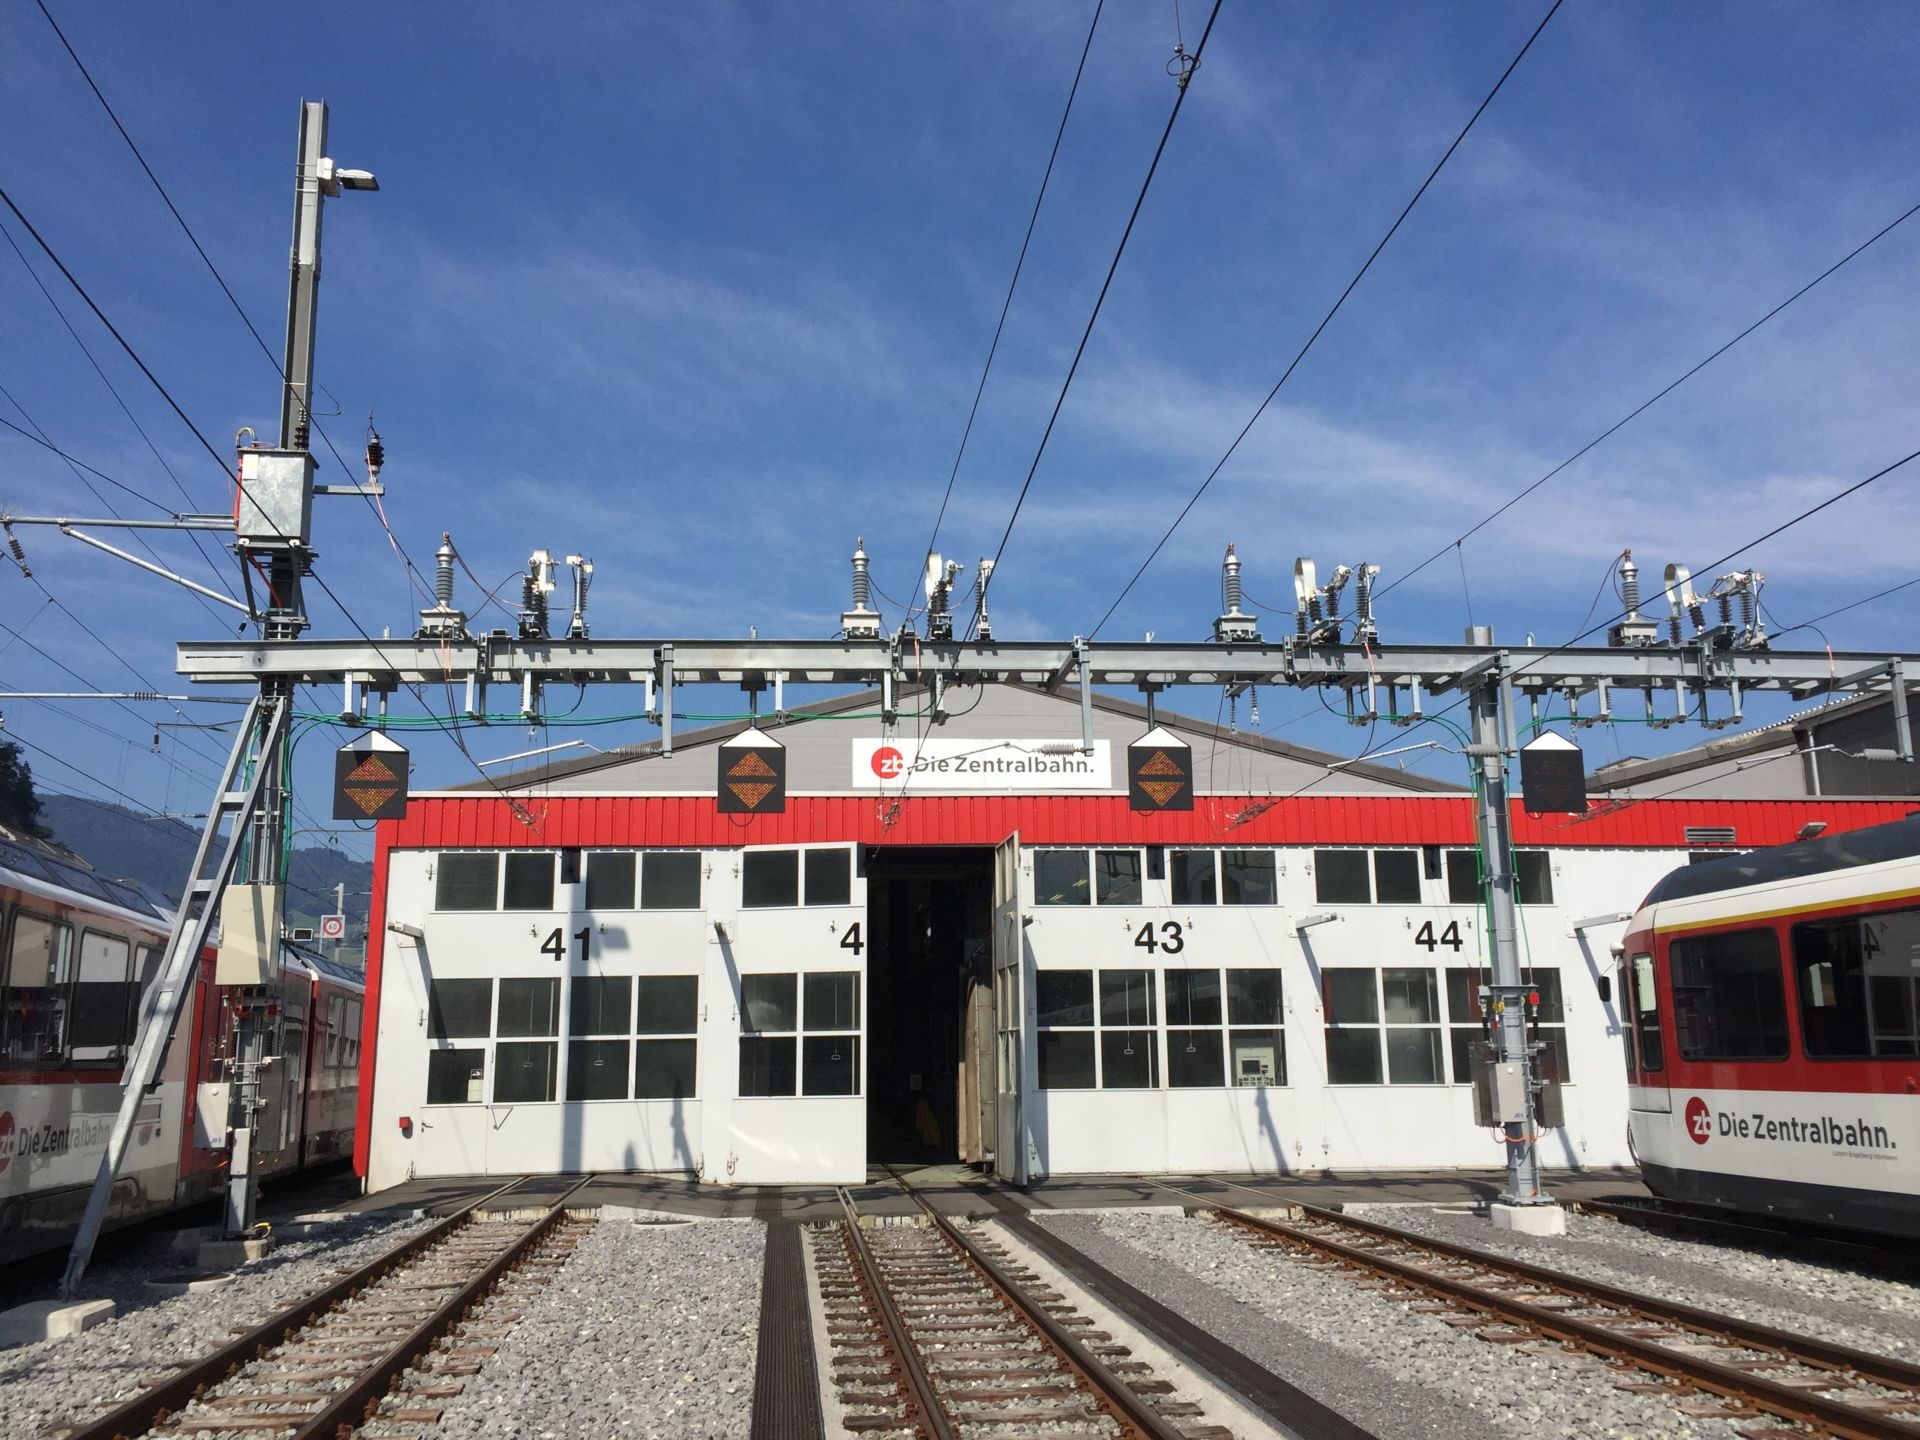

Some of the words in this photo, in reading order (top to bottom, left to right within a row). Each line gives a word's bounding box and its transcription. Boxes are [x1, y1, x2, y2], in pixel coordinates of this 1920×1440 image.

[880, 755, 904, 773] zb
[914, 755, 949, 773] Die
[955, 755, 1094, 773] Zentralbahn.
[541, 927, 590, 961] 41
[840, 922, 864, 955] 4
[1134, 921, 1184, 954] 43
[1414, 920, 1463, 952] 44
[18, 1126, 40, 1156] Die
[1692, 1109, 1712, 1137] zb
[1718, 1112, 1749, 1138] Die
[1752, 1114, 1896, 1149] Zentralbahn.
